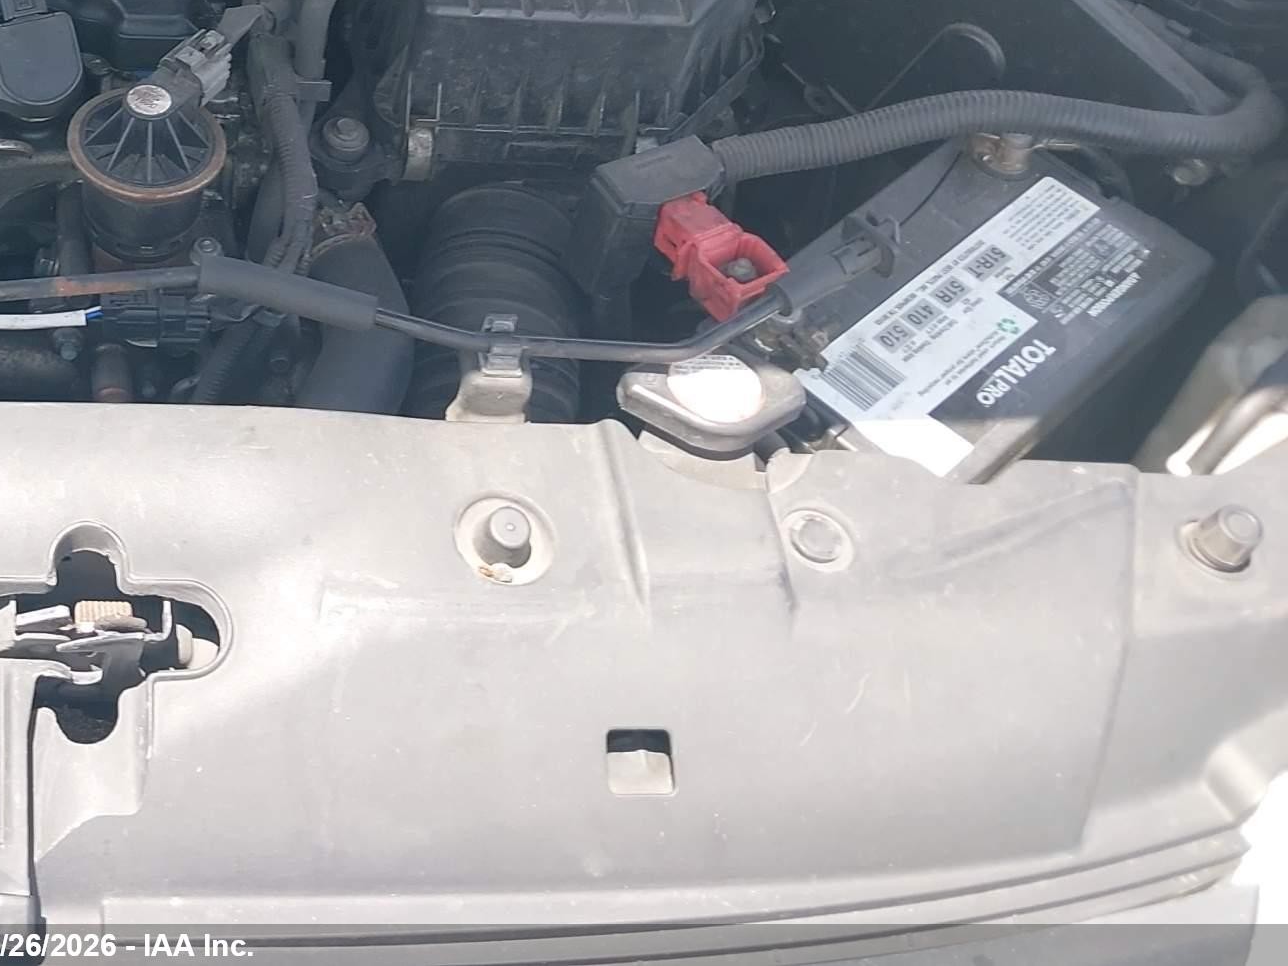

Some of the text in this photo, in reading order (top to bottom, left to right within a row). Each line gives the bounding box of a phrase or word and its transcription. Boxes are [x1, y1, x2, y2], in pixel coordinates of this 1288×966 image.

[964, 247, 1007, 280] 51R-T
[932, 279, 966, 306] 51R
[905, 303, 935, 327] 410
[877, 323, 908, 349] 510
[974, 338, 1056, 408] TOTALPRO
